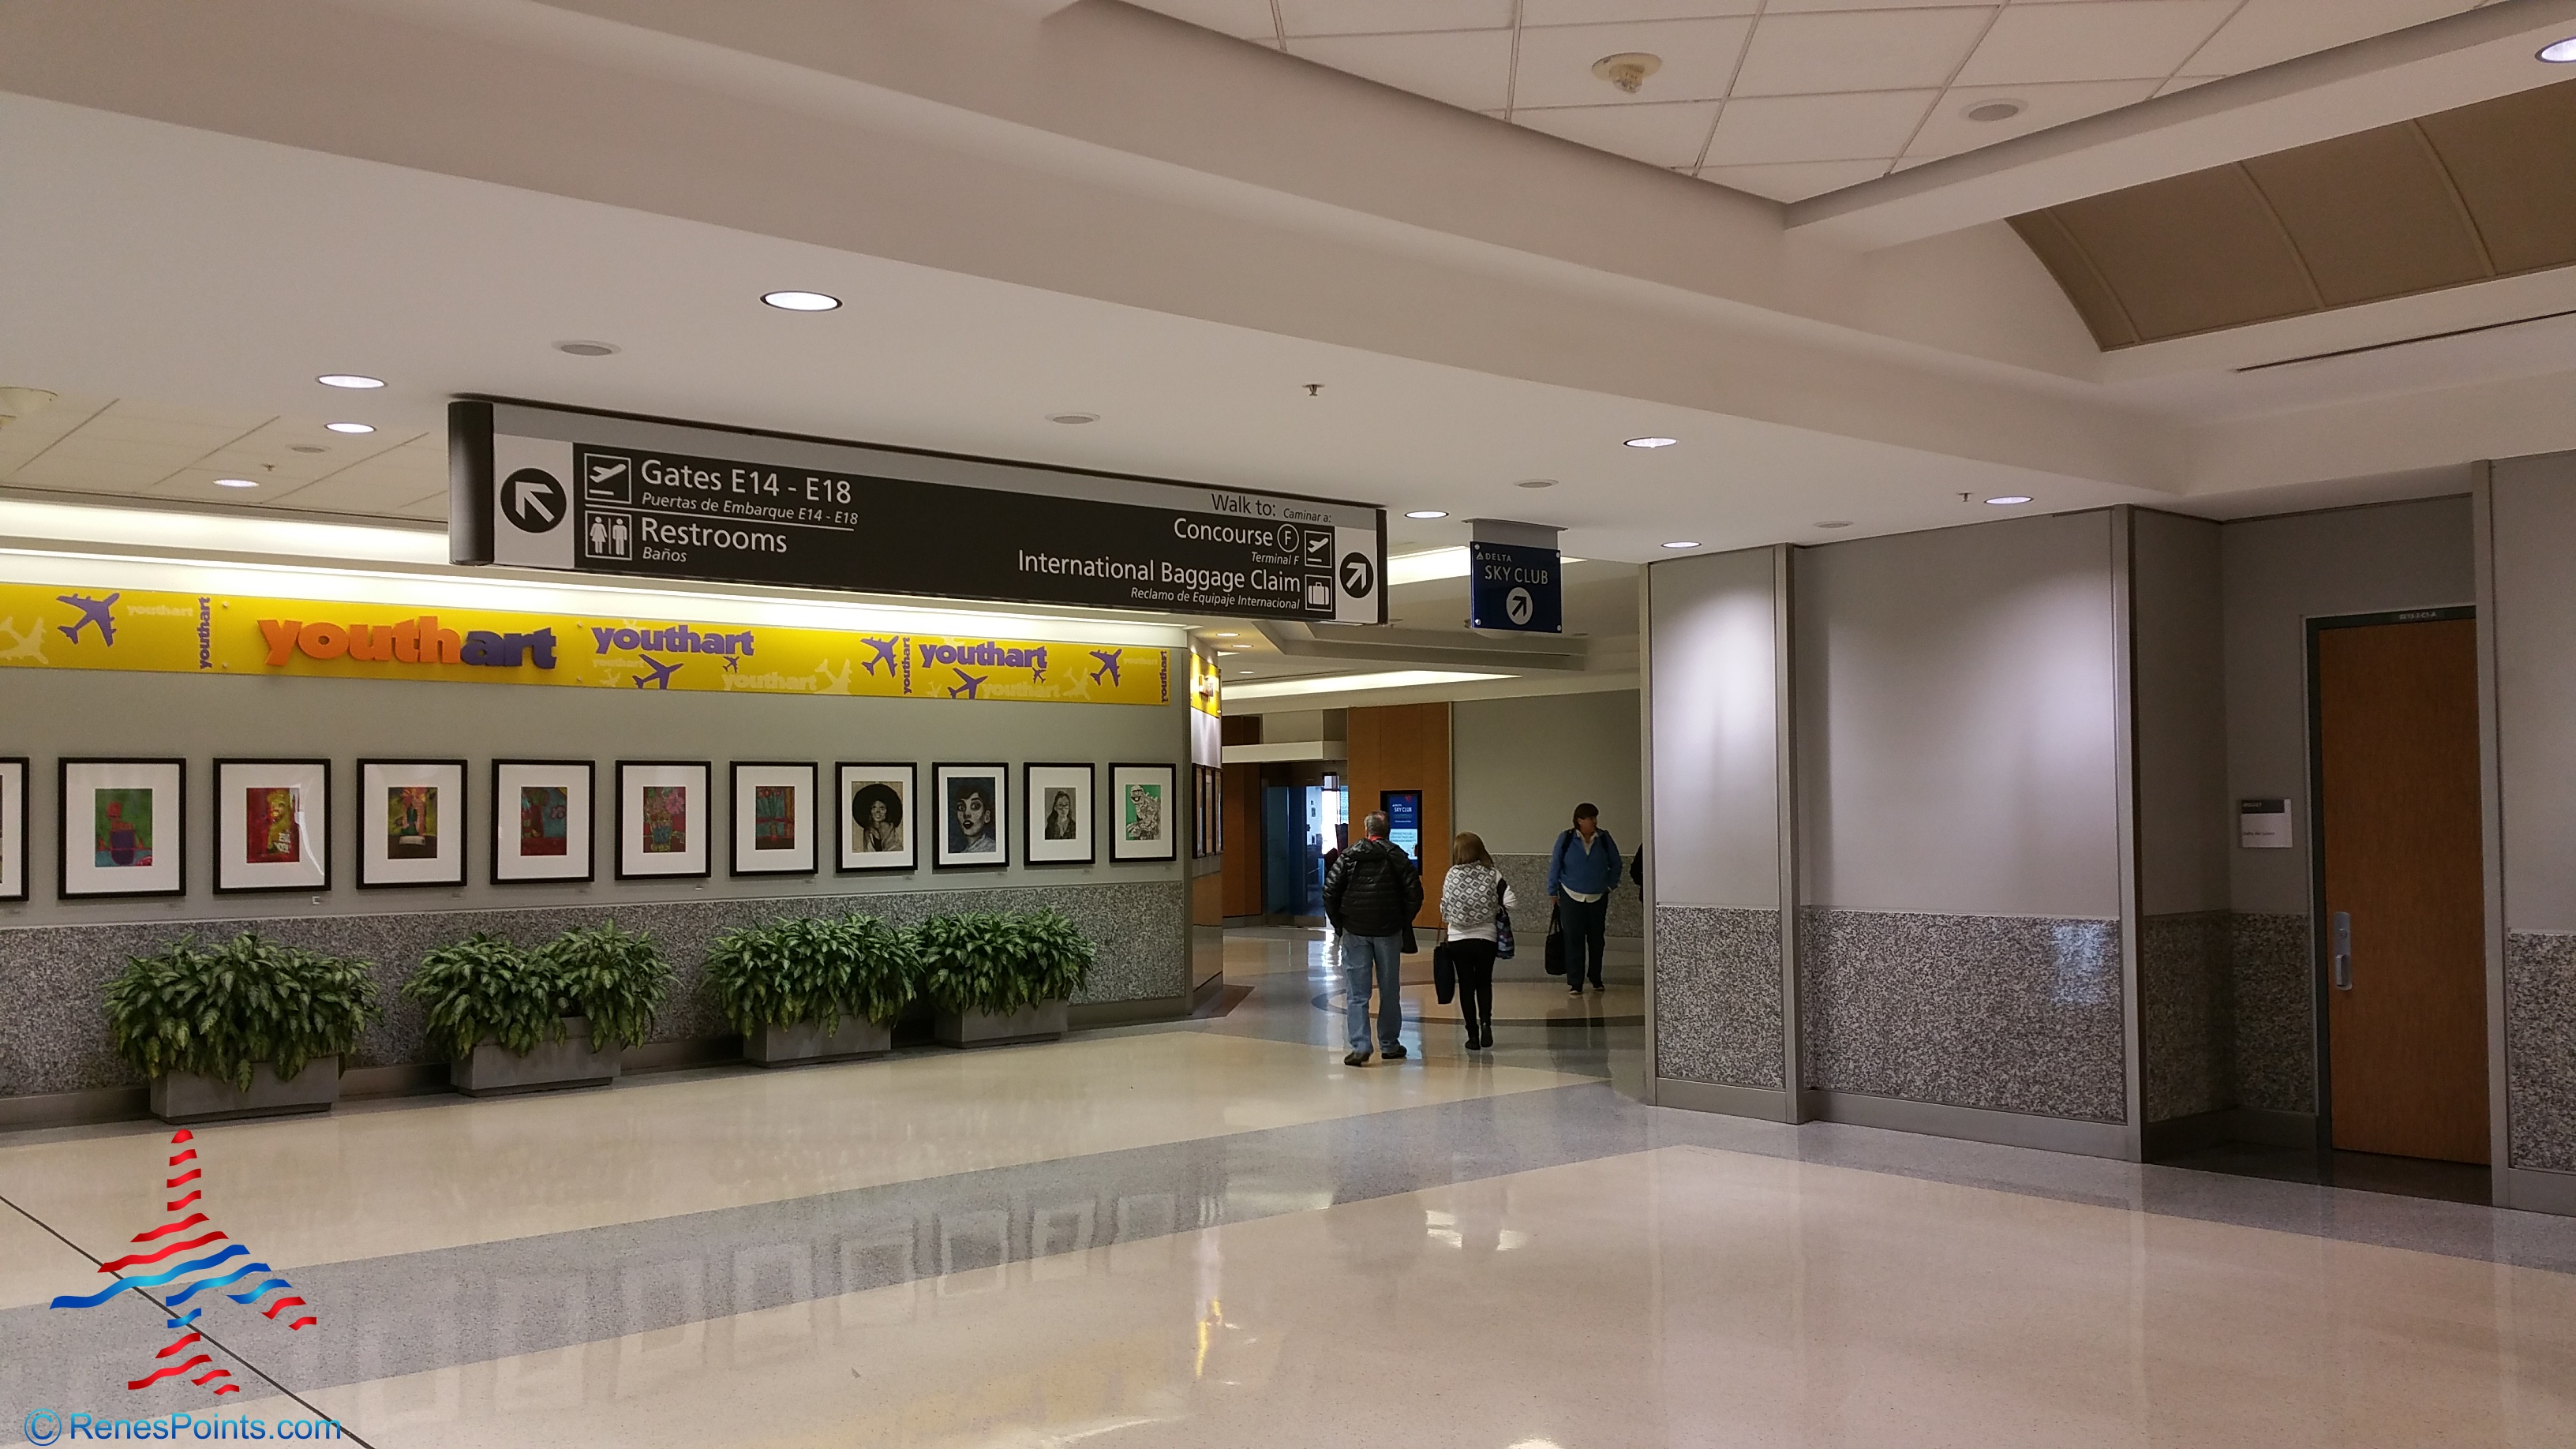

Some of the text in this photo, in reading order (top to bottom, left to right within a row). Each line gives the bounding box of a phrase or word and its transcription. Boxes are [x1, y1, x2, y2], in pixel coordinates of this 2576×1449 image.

[641, 459, 722, 491] Gates
[732, 469, 779, 496] E14
[807, 476, 852, 504] E18
[642, 492, 697, 511] Puertas
[701, 497, 719, 512] de
[723, 500, 795, 520] Embarque
[798, 508, 822, 522] E14
[834, 511, 859, 525] E18
[1211, 493, 1331, 522] Walk to: Caminar a:
[641, 517, 788, 553] Restrooms
[1174, 518, 1274, 547] Concourse
[642, 546, 687, 563] Baños
[1251, 551, 1300, 566] Terminal F
[1485, 552, 1512, 563] DELTA
[1019, 549, 1301, 593] International Baggage Claim
[1485, 564, 1548, 585] SKY CLUB
[126, 605, 194, 618] youthart
[1130, 586, 1301, 609] Reclamo de Equipaje Internacional
[197, 596, 213, 671] youthart
[257, 615, 558, 671] youthart
[590, 624, 755, 657] youthart
[901, 636, 912, 696] youthart
[918, 640, 1048, 669] youthart
[721, 671, 818, 692] youthart
[1159, 650, 1169, 704] youthart
